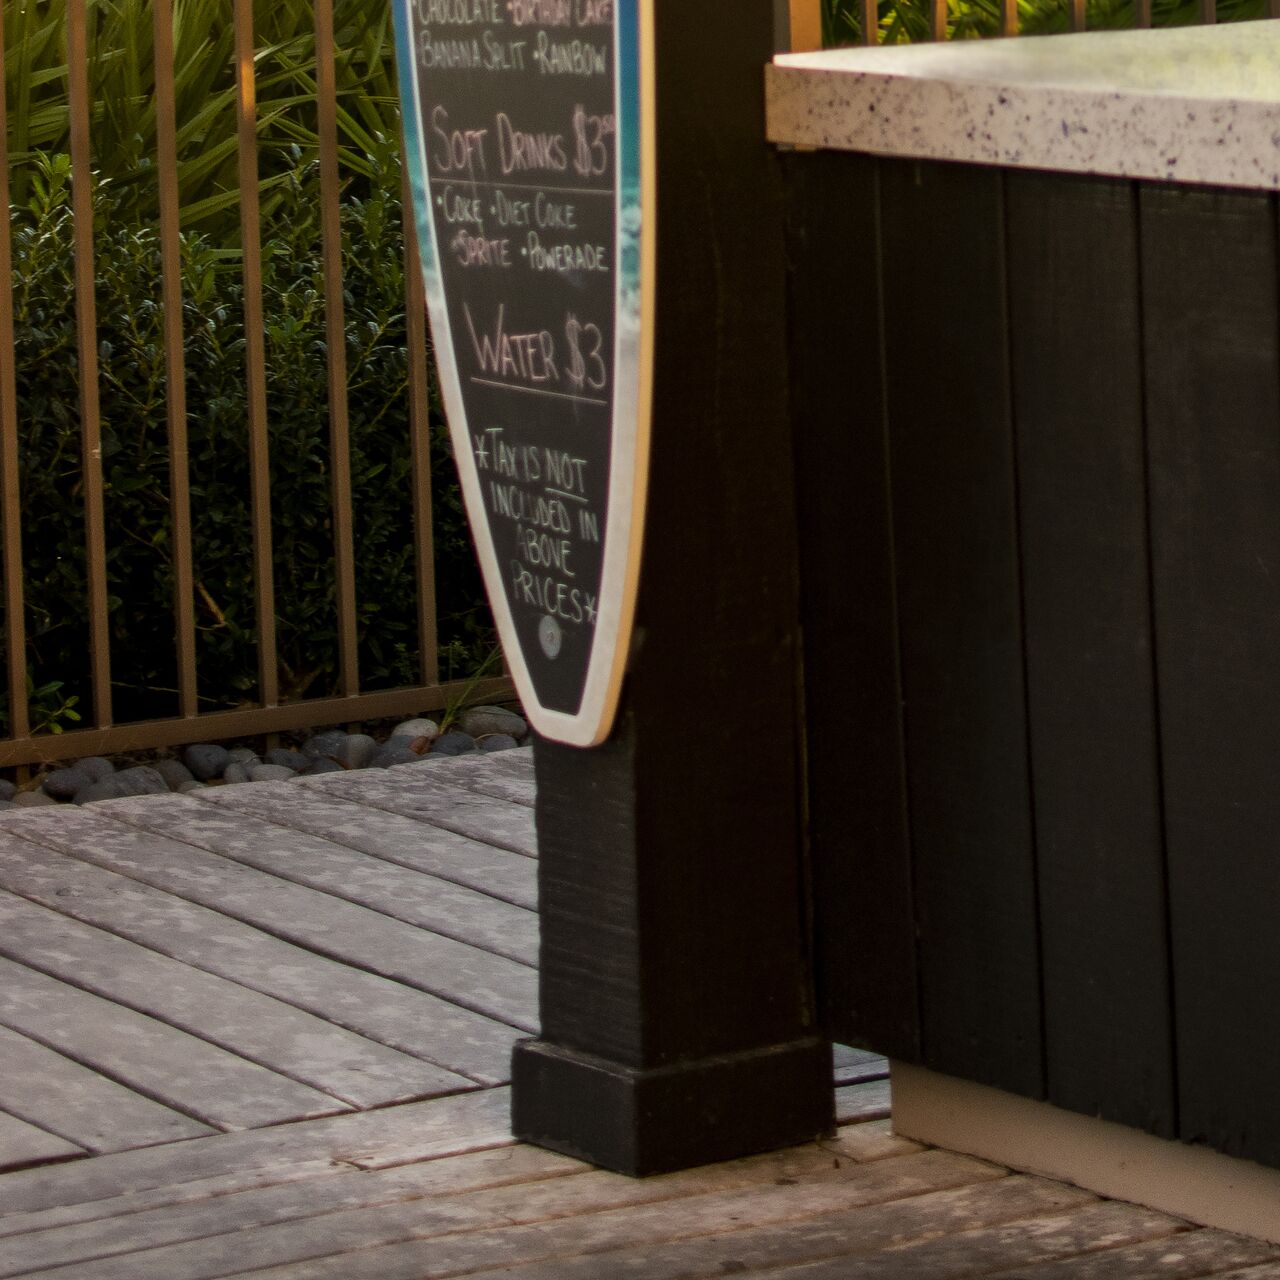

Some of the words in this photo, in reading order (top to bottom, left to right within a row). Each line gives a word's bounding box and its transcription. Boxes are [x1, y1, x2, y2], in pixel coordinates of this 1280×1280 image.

[431, 104, 488, 182] SOFT
[496, 112, 567, 174] DRINKS
[527, 231, 610, 273] POWERADE
[463, 300, 559, 381] WATER
[565, 310, 608, 390] $3
[522, 445, 542, 483] IS
[544, 447, 588, 494] NOT
[489, 480, 572, 535] INCLUDED
[579, 508, 600, 543] IN
[516, 522, 577, 578] ABOVE
